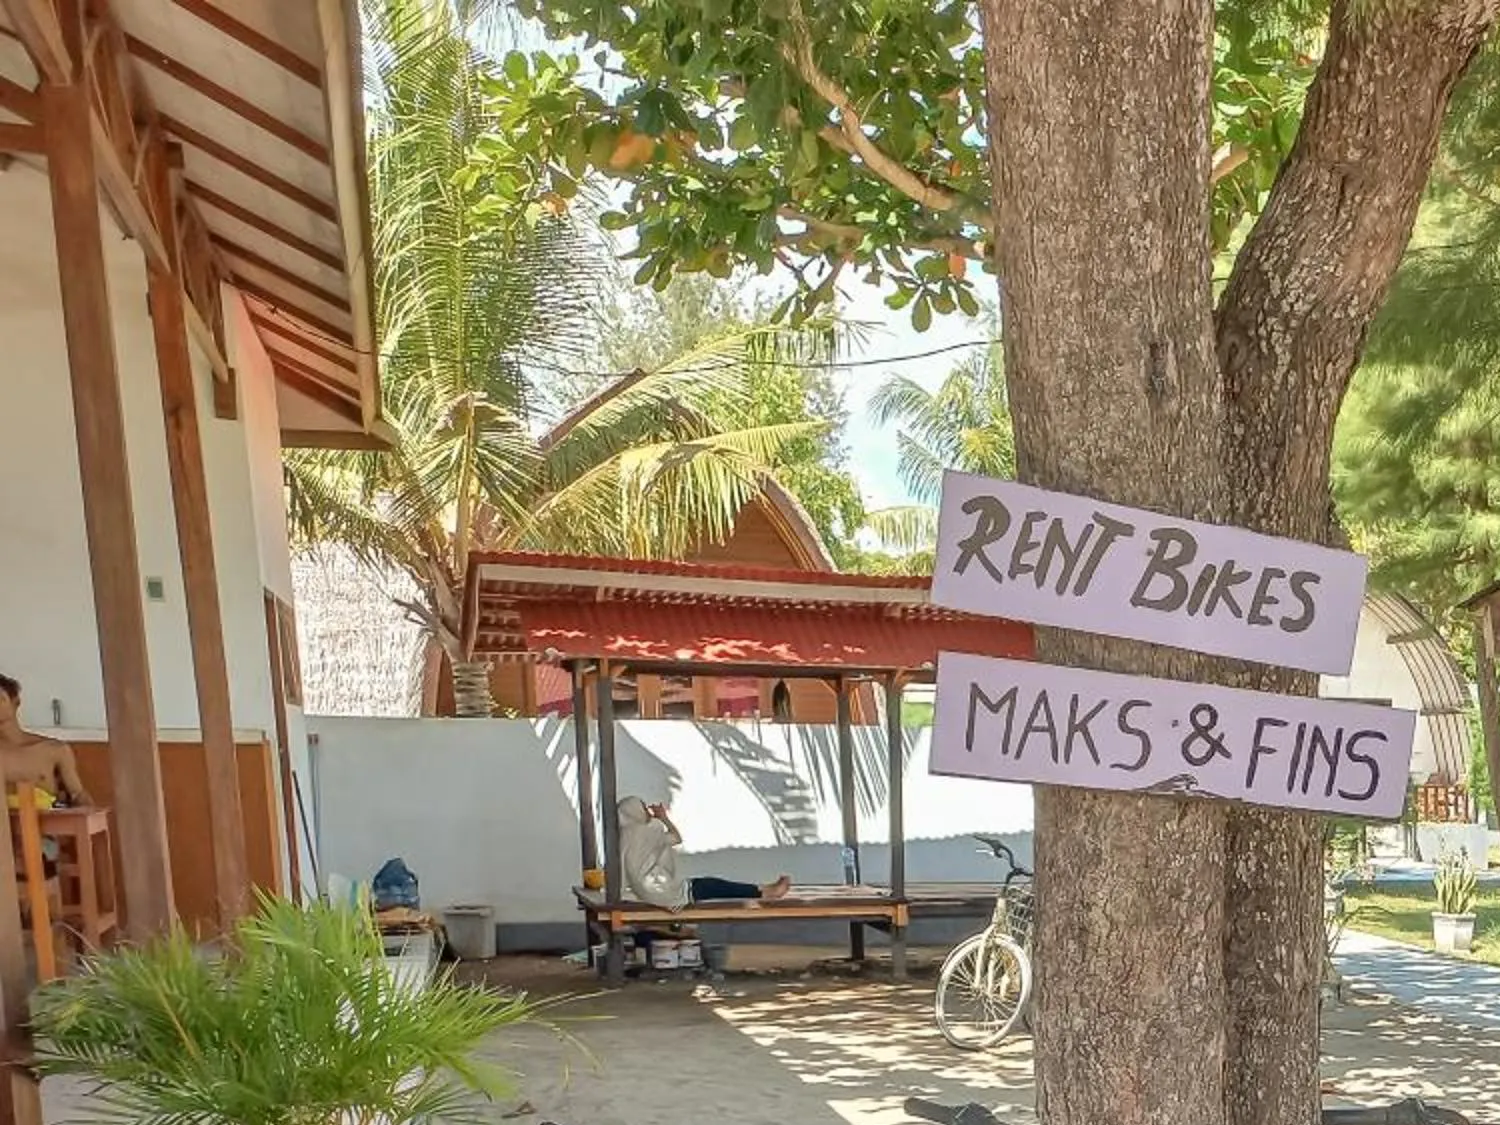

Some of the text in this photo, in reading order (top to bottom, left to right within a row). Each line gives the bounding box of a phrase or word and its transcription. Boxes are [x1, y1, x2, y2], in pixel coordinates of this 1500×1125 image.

[952, 495, 1321, 633] RENT BIKES
[964, 681, 1389, 801] MAKS & FINS
